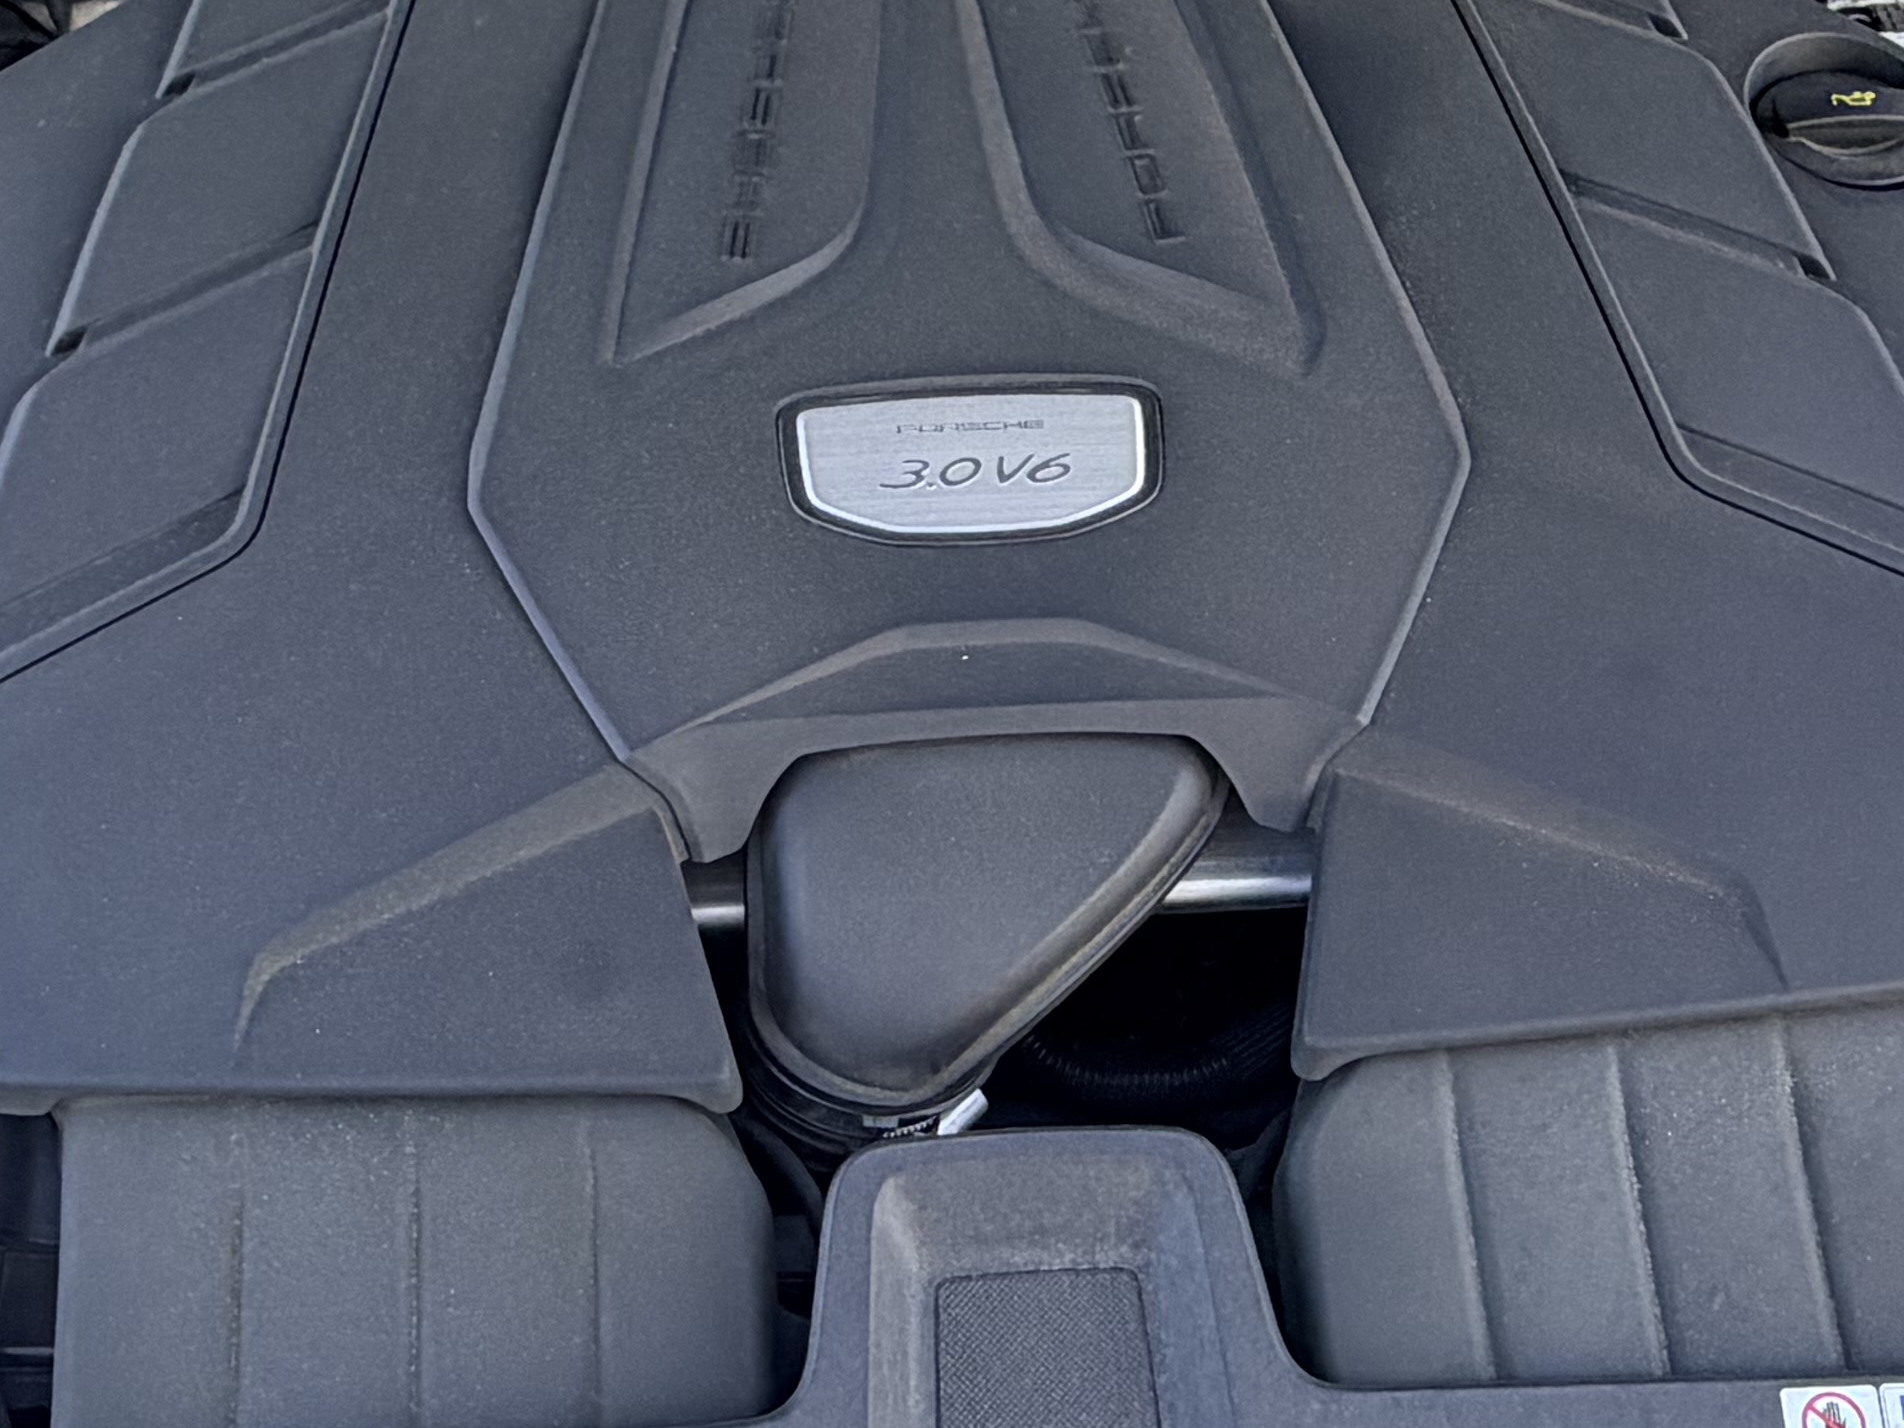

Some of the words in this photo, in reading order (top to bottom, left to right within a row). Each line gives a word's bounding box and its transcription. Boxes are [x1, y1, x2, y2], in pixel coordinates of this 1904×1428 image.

[895, 419, 1045, 434] PORSCHE
[879, 457, 983, 490] 3.0
[996, 452, 1071, 484] V6
